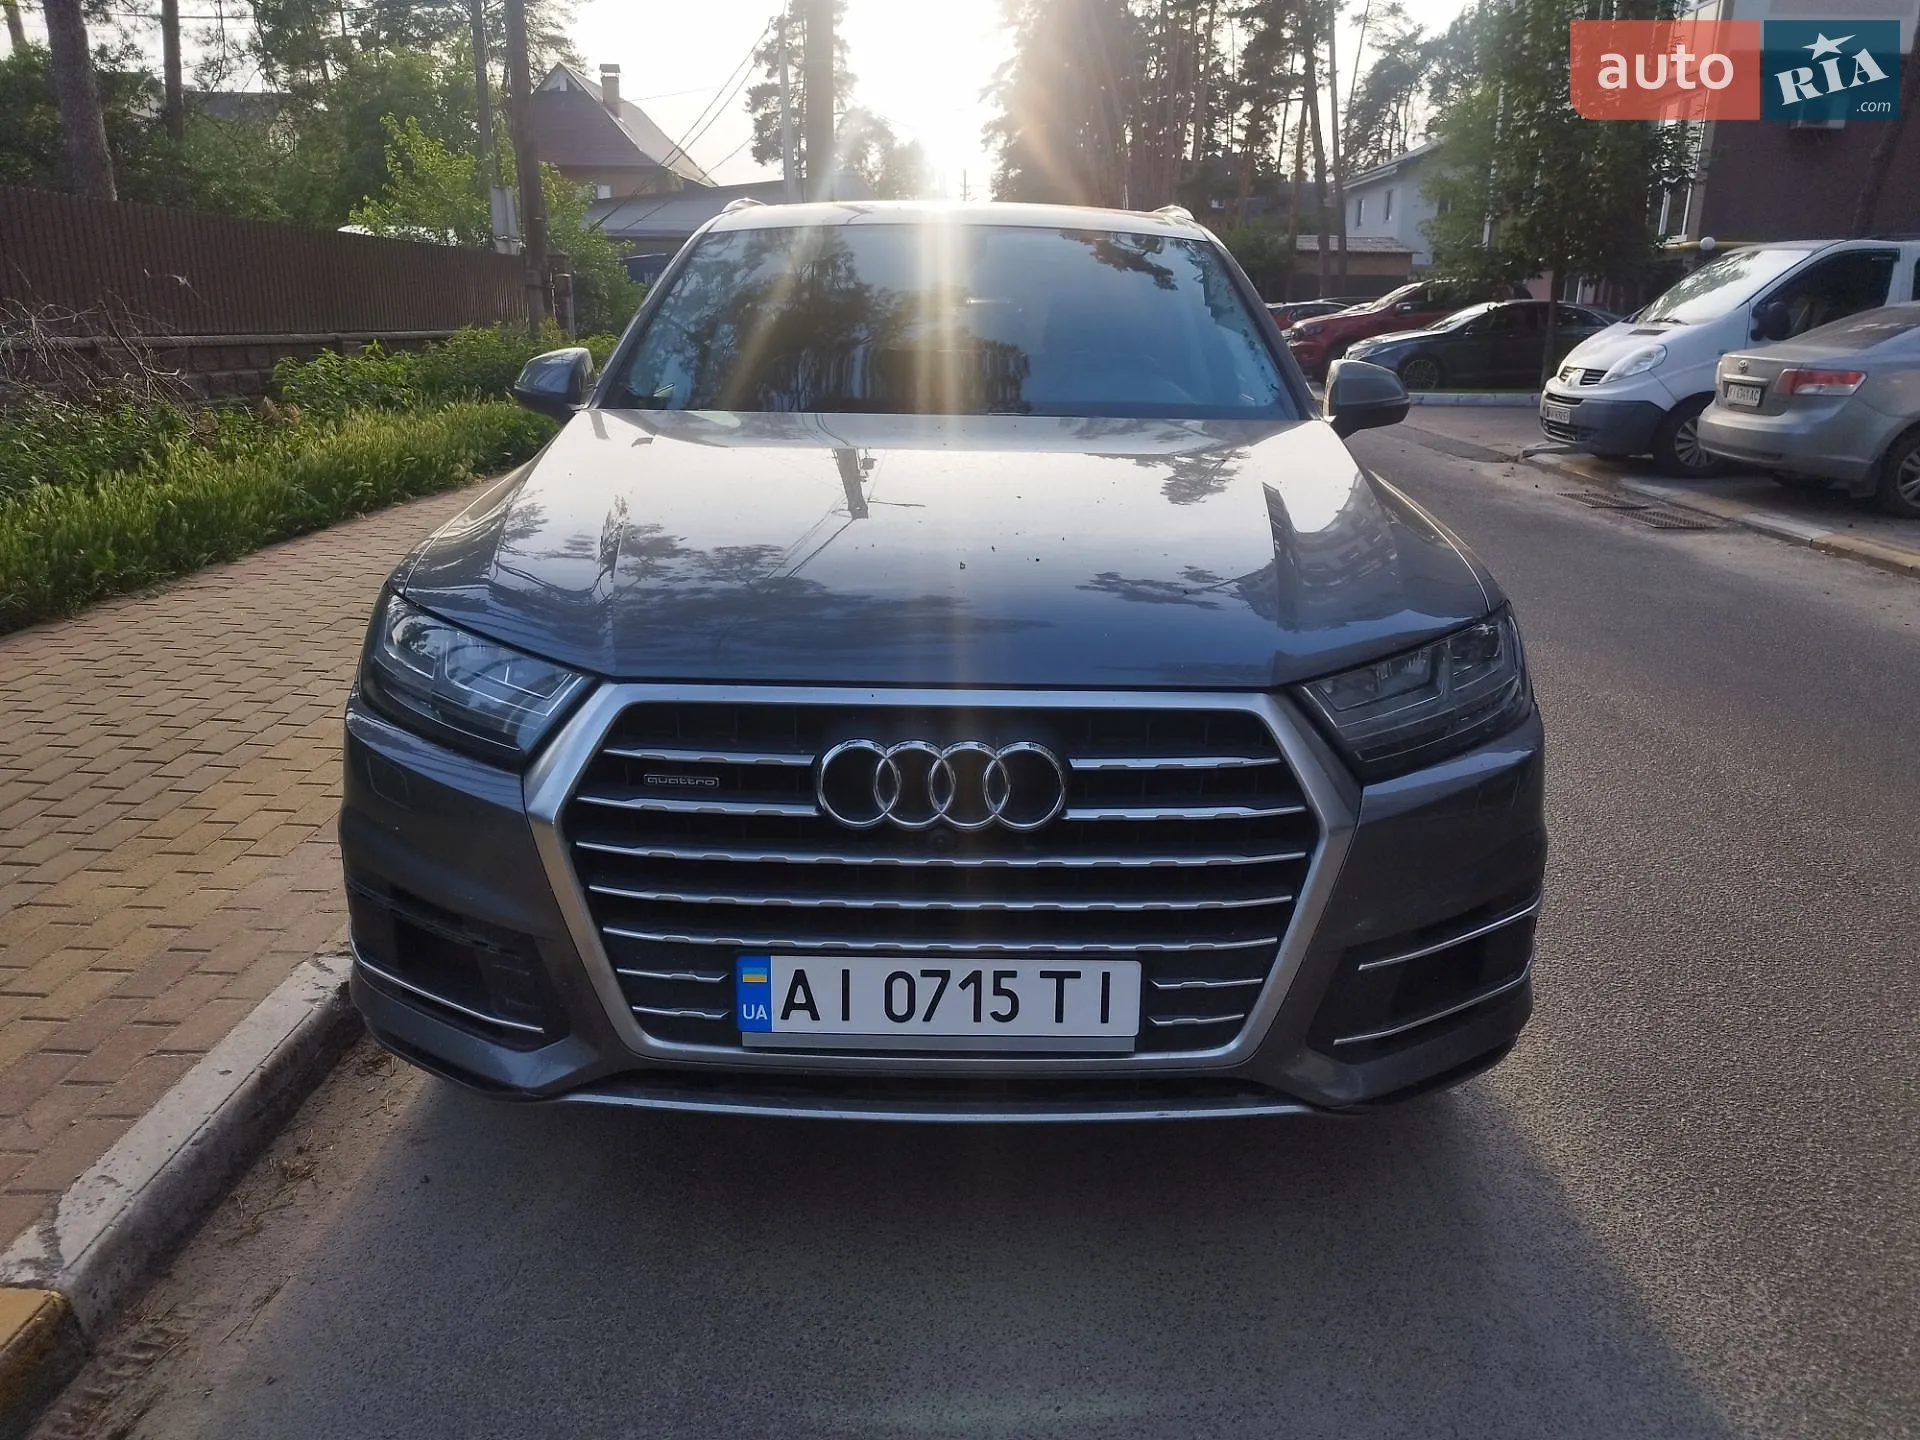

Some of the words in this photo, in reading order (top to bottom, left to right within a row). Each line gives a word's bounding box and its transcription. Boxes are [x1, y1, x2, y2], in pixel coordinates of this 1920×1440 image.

[647, 777, 715, 786] quattro
[780, 968, 850, 1021] AI
[884, 970, 1019, 1023] 0715
[1039, 970, 1111, 1024] TI
[742, 1004, 768, 1021] UA
